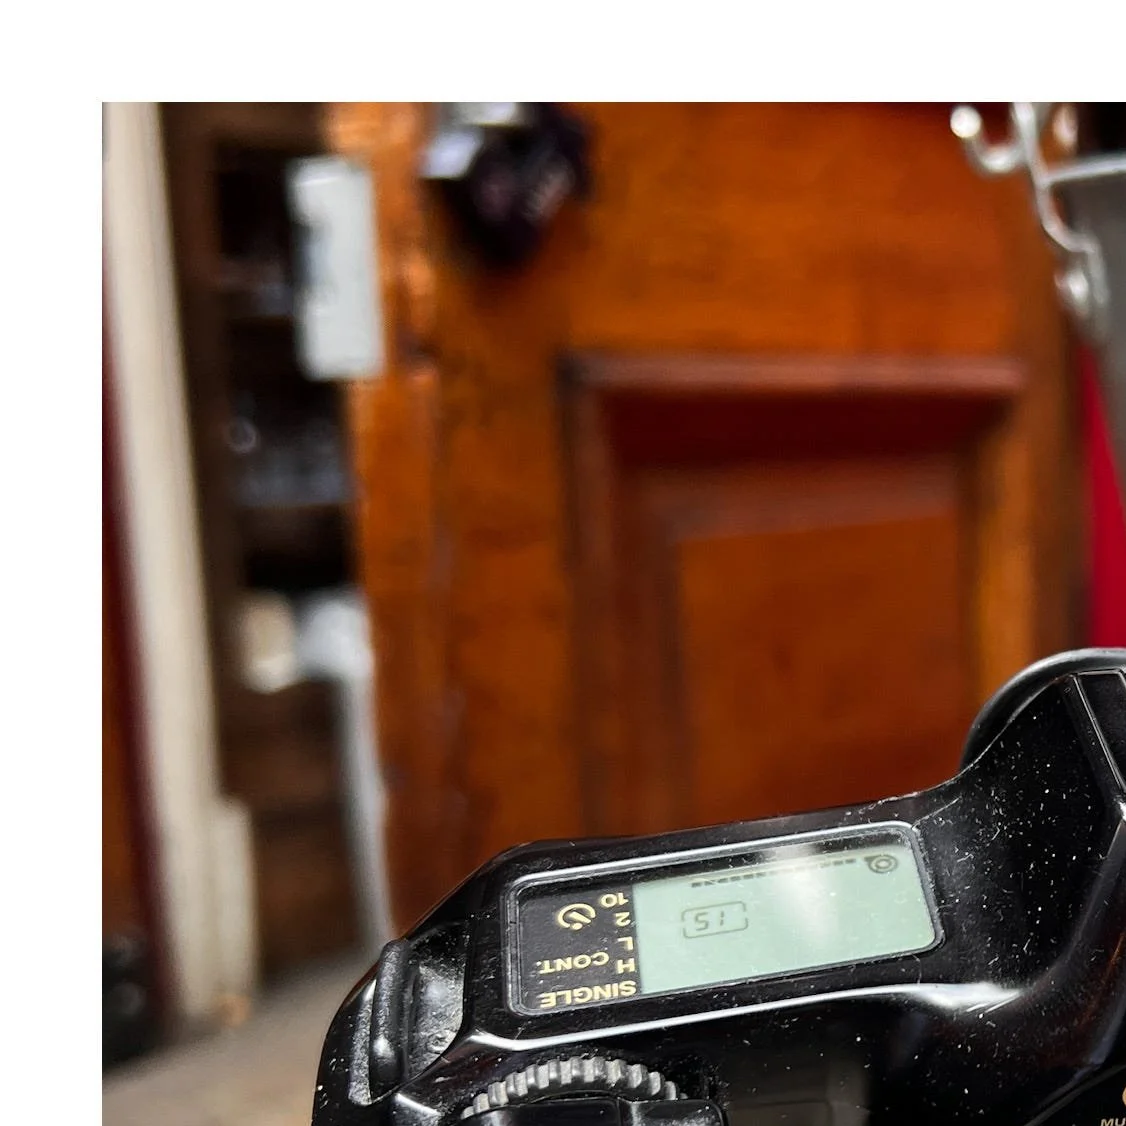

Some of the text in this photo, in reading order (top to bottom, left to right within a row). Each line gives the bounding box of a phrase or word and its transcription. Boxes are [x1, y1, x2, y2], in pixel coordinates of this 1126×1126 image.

[600, 892, 629, 908] 10
[615, 911, 631, 927] 2
[617, 936, 634, 951] L
[617, 957, 636, 974] H
[538, 980, 637, 1008] SINGLE
